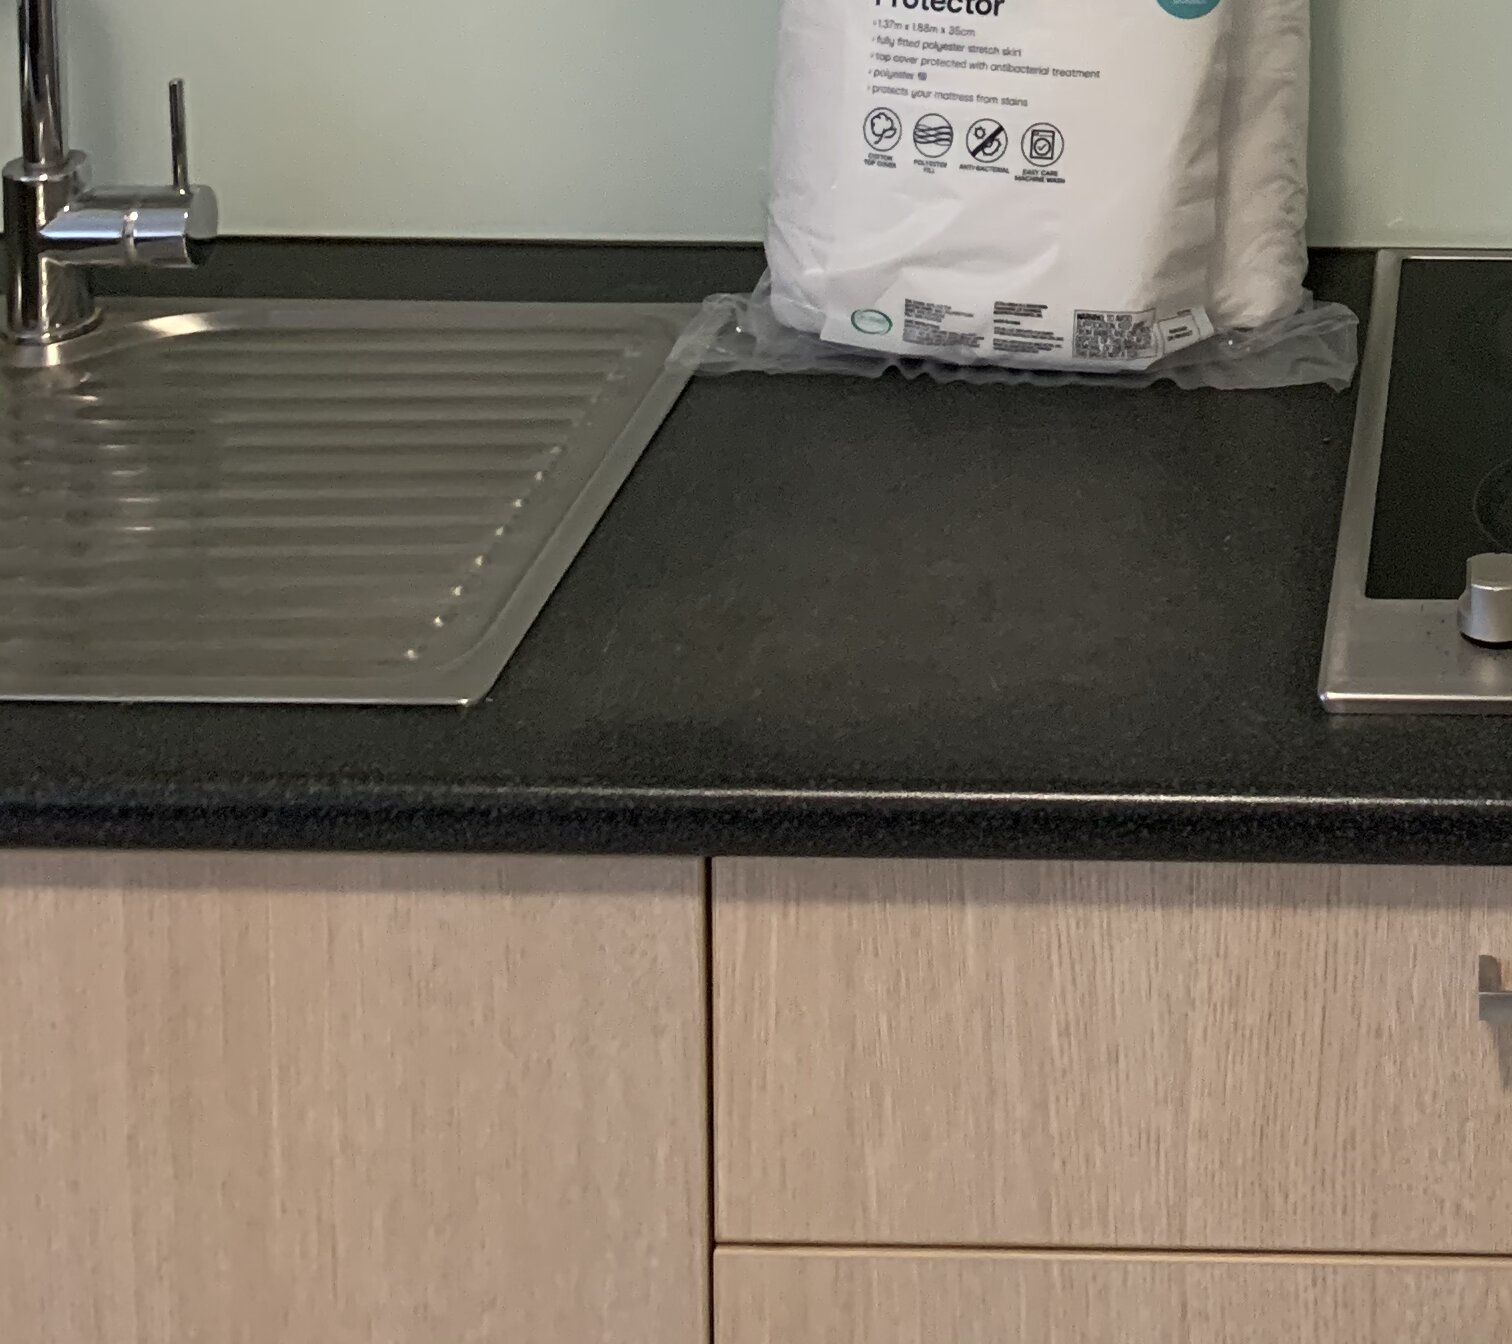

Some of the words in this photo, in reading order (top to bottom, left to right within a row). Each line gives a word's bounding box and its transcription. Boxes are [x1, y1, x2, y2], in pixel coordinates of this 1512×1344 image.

[949, 26, 976, 37] 35cm
[877, 36, 895, 48] fully
[897, 37, 920, 49] fitted
[922, 41, 965, 53] polyester
[875, 52, 891, 63] top
[893, 55, 918, 65] cover
[920, 57, 967, 69] protected
[969, 61, 988, 70] with
[990, 63, 1050, 76] antibacterial
[1052, 67, 1100, 78] treatment
[871, 84, 909, 96] protects
[911, 89, 932, 99] your
[934, 91, 974, 103] mattress
[976, 93, 998, 104] from
[1000, 97, 1028, 107] stains
